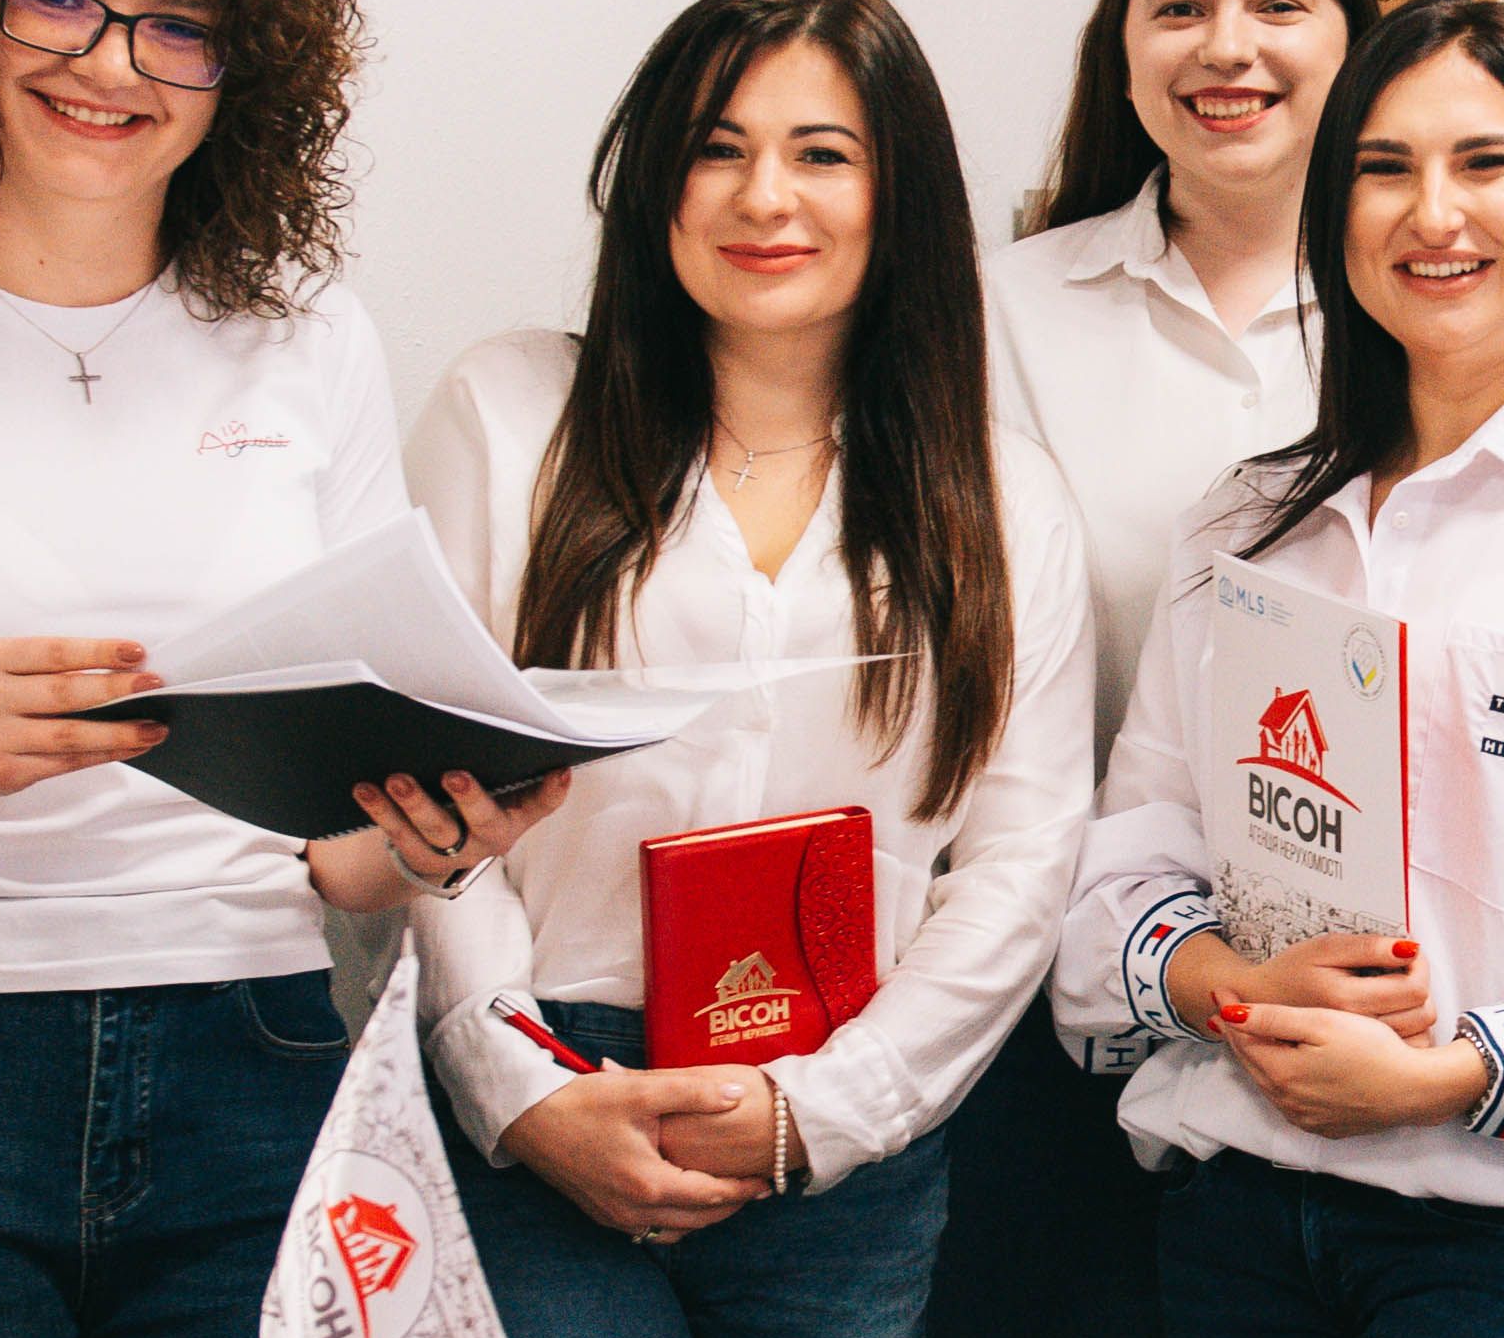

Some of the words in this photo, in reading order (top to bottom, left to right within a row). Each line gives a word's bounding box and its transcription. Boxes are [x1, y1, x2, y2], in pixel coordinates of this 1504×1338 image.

[1236, 585, 1265, 615] MLS
[1249, 771, 1342, 854] ВІСОН
[1280, 837, 1343, 881] НЕРУХОМОСТІ
[709, 997, 790, 1035] ВІСОН
